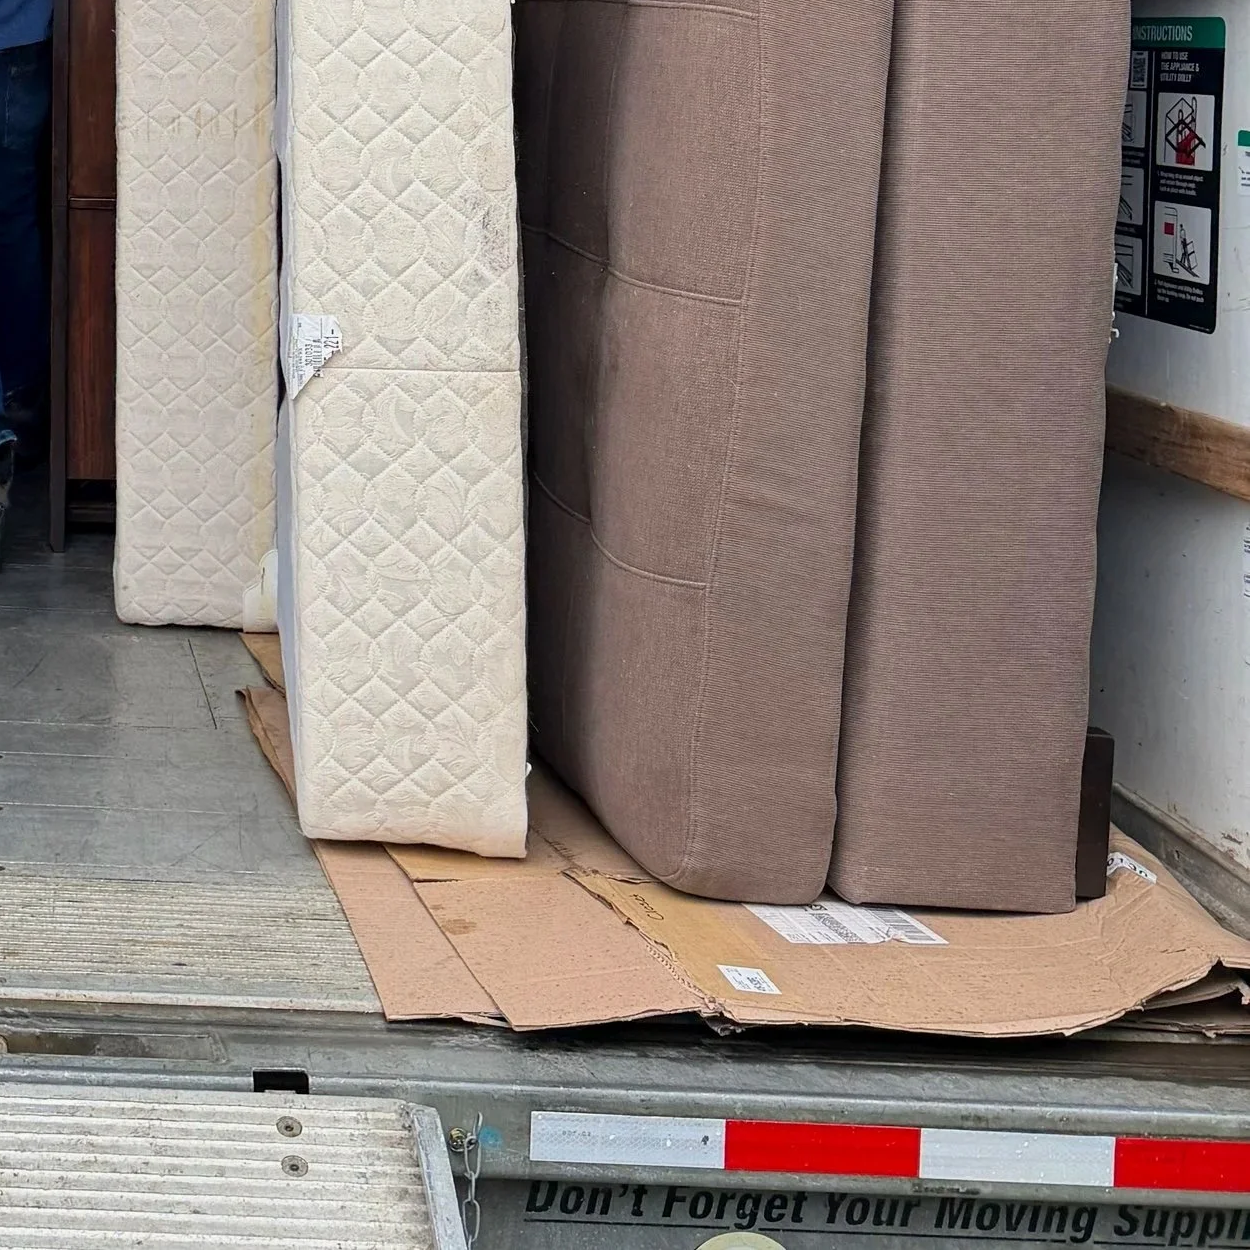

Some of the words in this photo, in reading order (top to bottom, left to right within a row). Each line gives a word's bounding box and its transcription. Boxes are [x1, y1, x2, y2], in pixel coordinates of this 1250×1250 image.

[1179, 51, 1188, 61] USE
[1170, 61, 1195, 72] APPLIANCE
[525, 1180, 648, 1217] Don't
[661, 1185, 807, 1230] Forget
[825, 1192, 921, 1228] Your
[934, 1197, 1099, 1244] Moving
